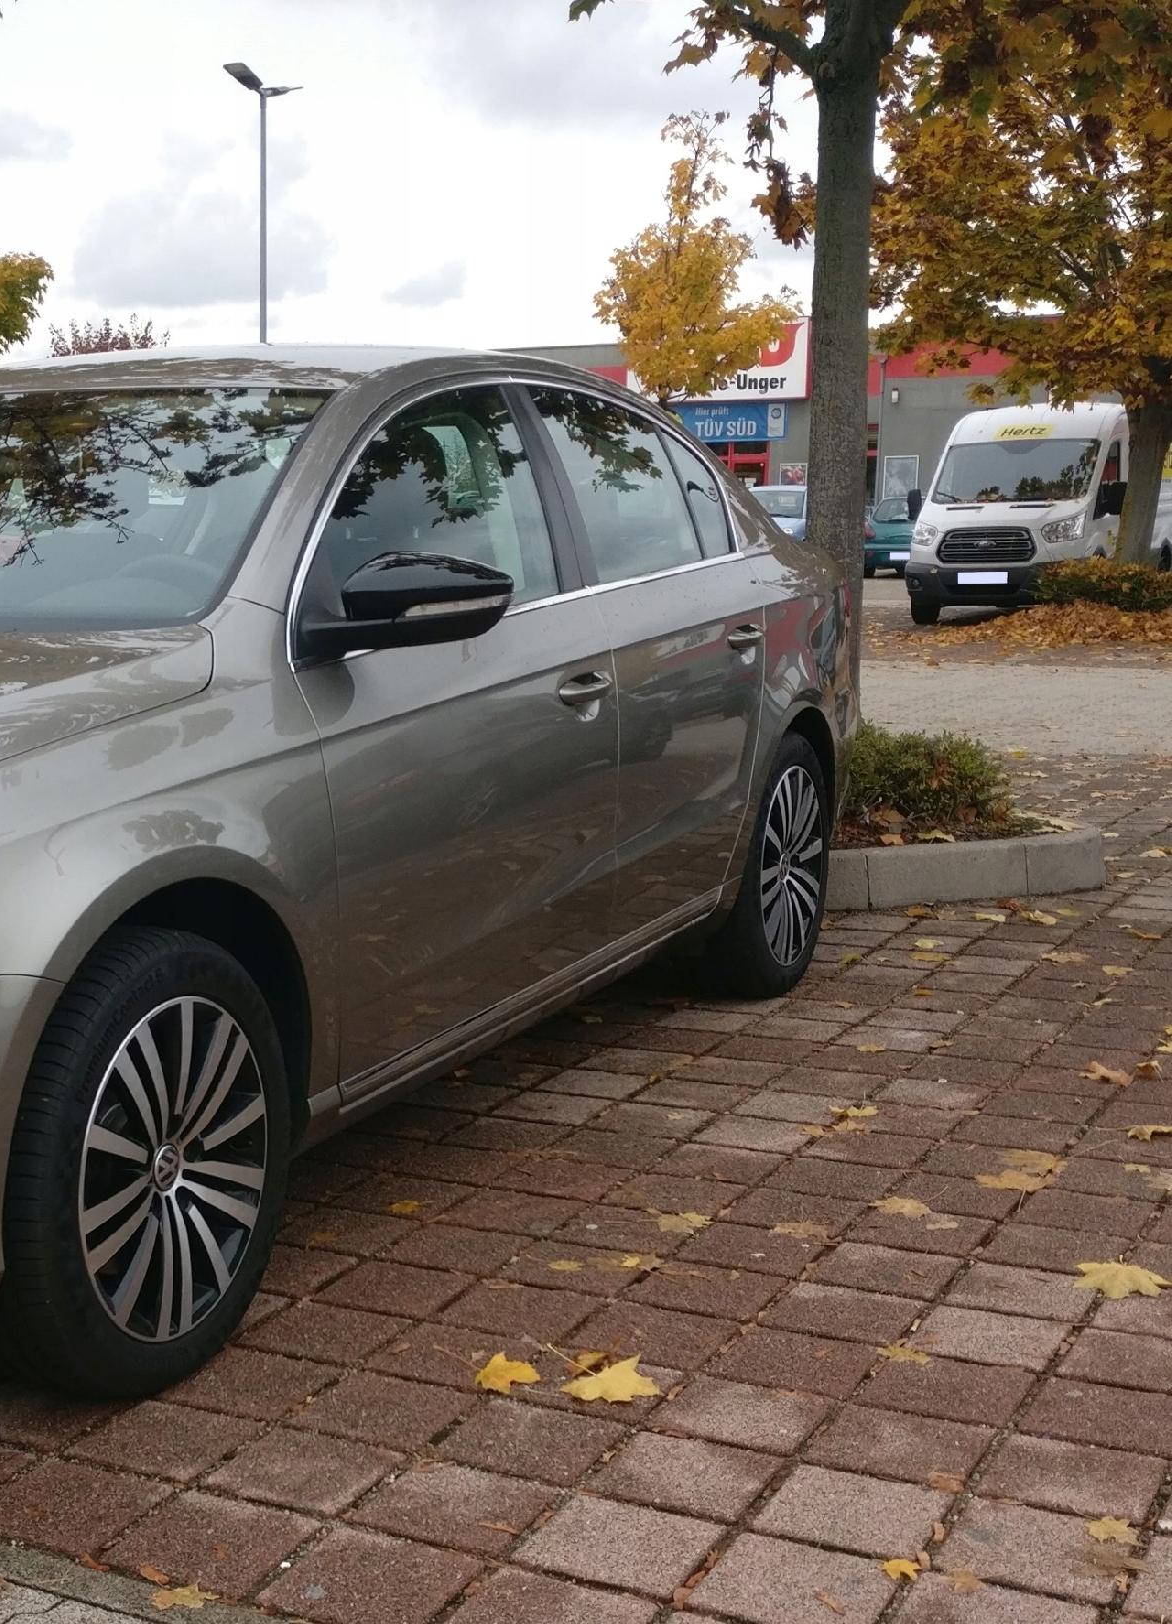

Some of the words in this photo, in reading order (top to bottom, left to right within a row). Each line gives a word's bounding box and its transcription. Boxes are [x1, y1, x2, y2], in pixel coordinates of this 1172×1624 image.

[694, 418, 724, 438] TÜV
[726, 417, 757, 437] SÜD
[1000, 426, 1047, 437] Hertz
